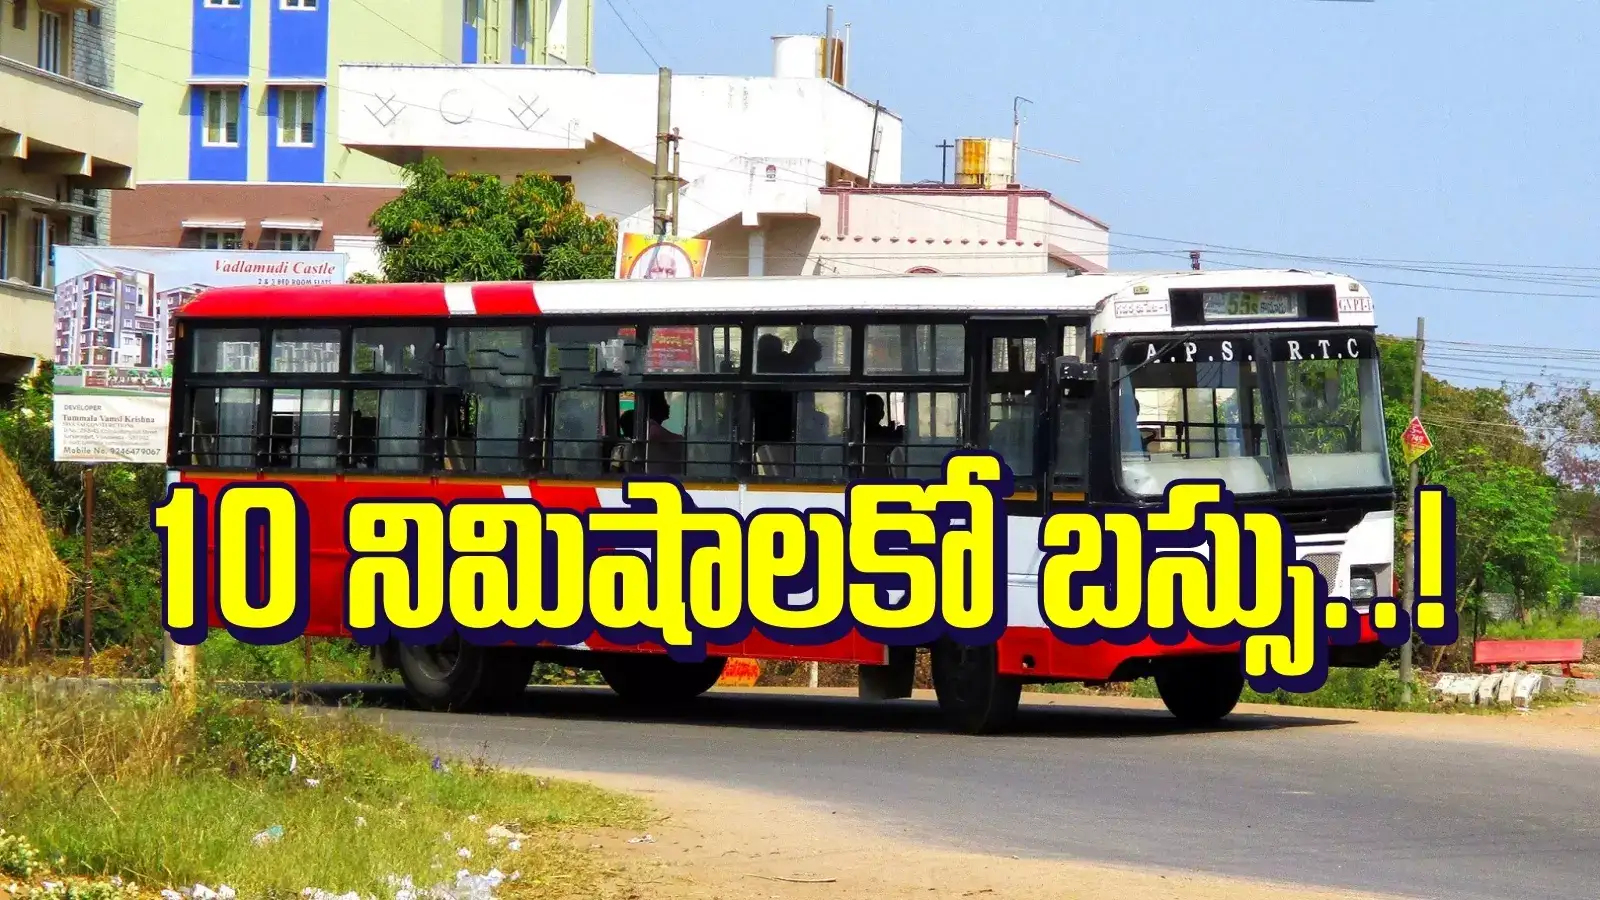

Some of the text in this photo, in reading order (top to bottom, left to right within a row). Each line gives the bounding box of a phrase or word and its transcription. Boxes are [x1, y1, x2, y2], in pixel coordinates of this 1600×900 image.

[214, 259, 336, 275] Vadlamudi Castle
[63, 414, 98, 422] Tummala
[99, 415, 123, 423] Vamsi
